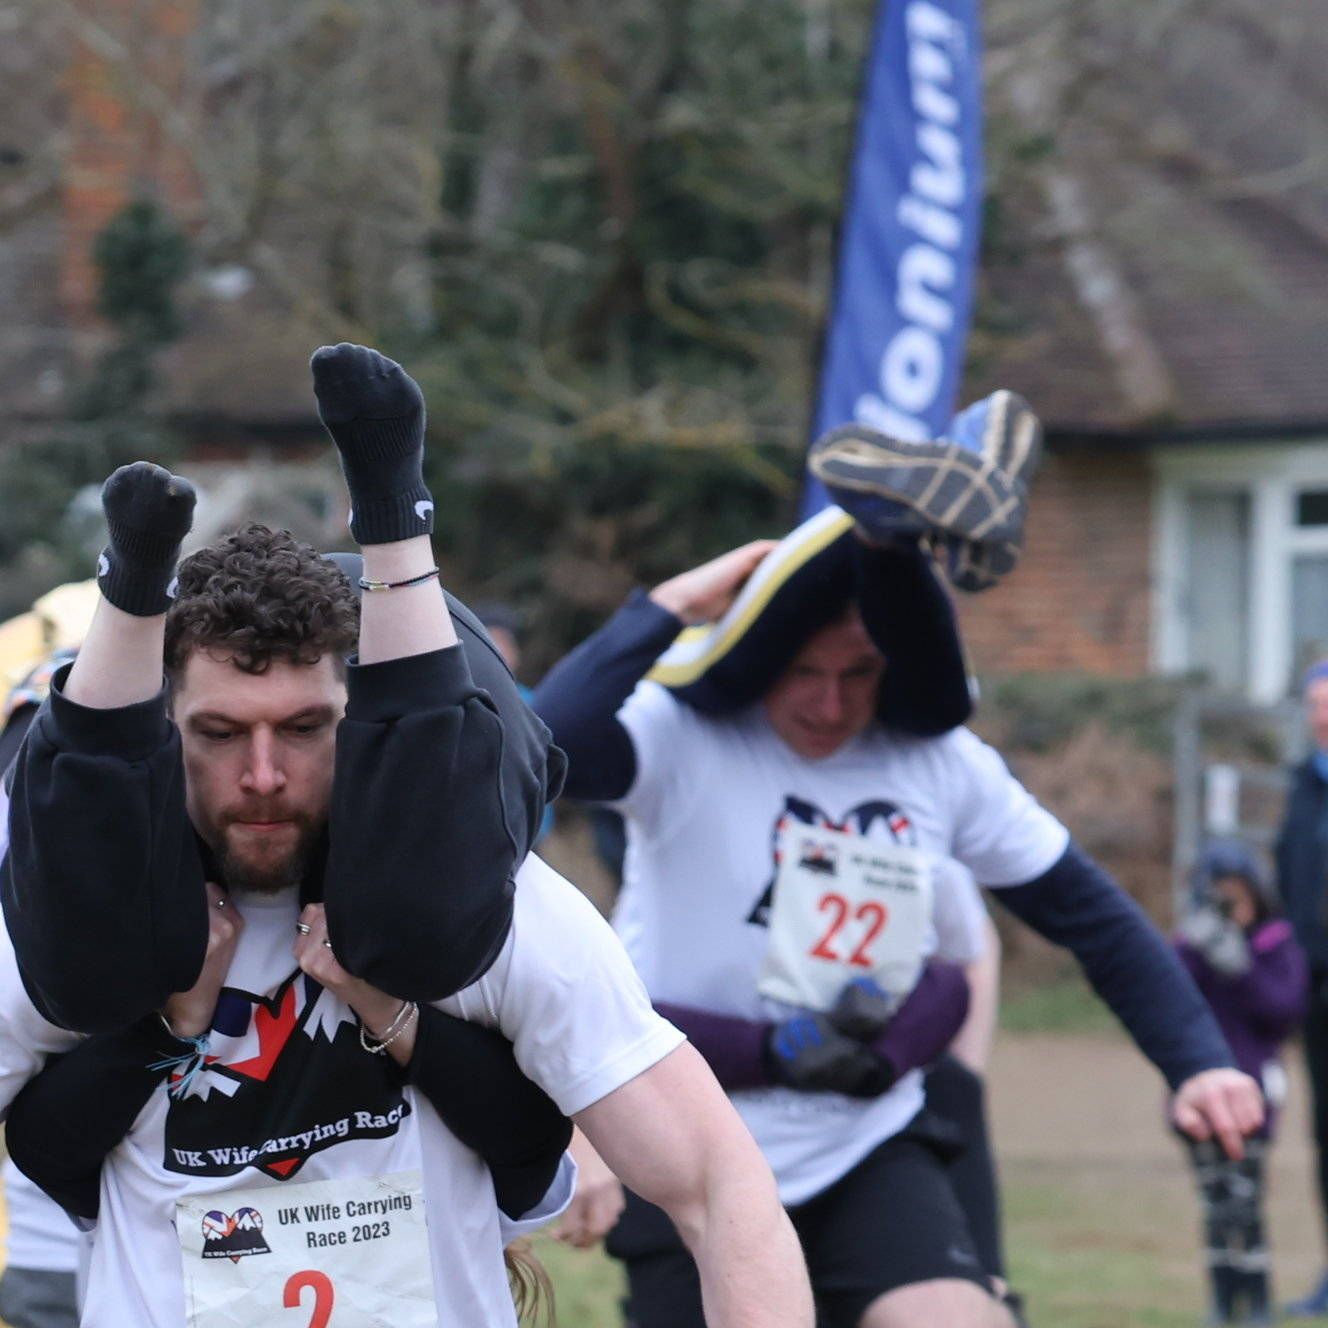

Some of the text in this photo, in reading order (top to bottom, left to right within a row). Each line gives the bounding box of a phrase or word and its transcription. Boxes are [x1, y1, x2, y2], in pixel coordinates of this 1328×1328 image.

[811, 892, 888, 968] 22
[172, 1148, 207, 1167] UK
[207, 1146, 258, 1165] Wife
[277, 1195, 413, 1226] UK Wife Carrying
[306, 1221, 391, 1249] Race 2023
